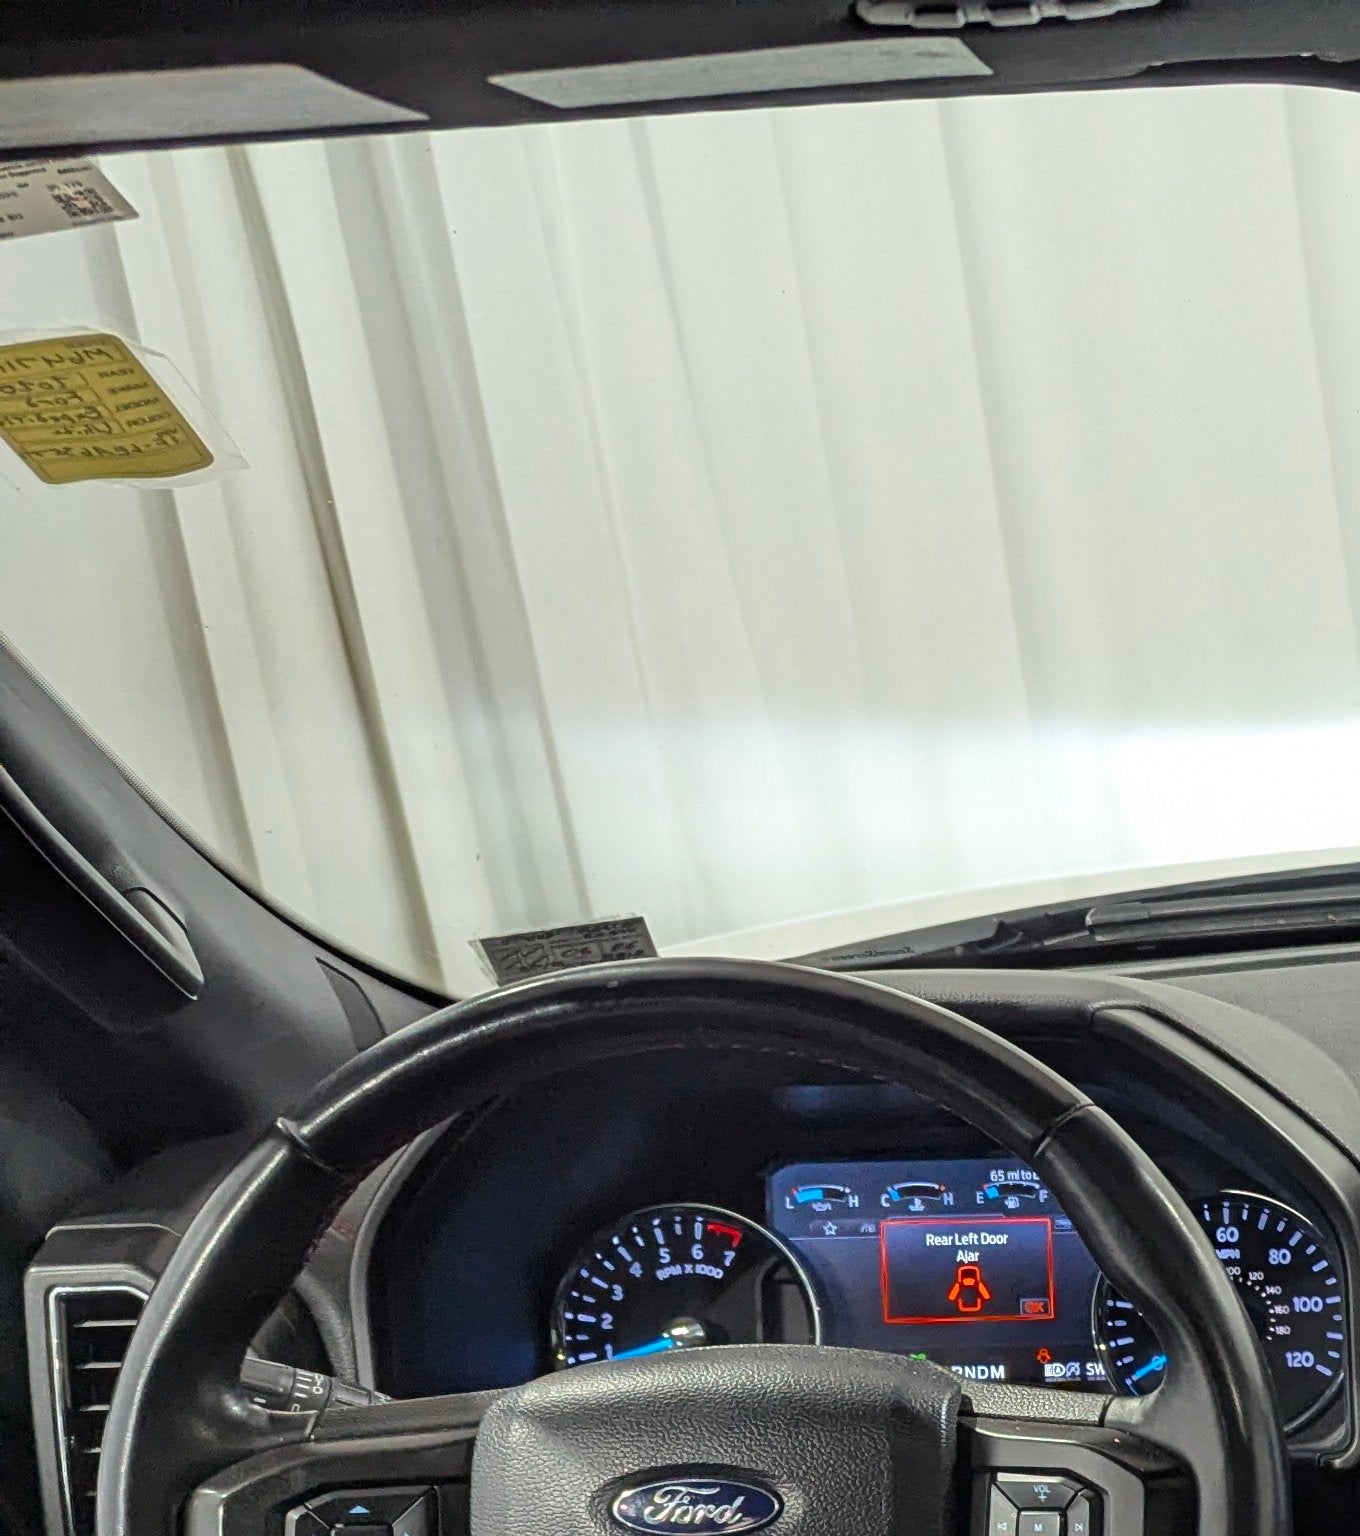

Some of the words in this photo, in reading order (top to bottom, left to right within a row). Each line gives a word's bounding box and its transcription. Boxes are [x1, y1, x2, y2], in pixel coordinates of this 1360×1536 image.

[990, 1170, 1005, 1182] 65
[785, 1197, 794, 1210] L
[848, 1195, 859, 1208] H
[880, 1194, 890, 1208] C
[943, 1193, 953, 1206] H
[976, 1191, 984, 1204] E
[926, 1233, 953, 1246] Rear
[954, 1232, 978, 1246] Left
[981, 1231, 1009, 1245] Door
[1215, 1226, 1239, 1243] 60
[658, 1247, 671, 1264] 5
[691, 1244, 704, 1260] 6
[723, 1250, 736, 1267] 7
[956, 1250, 979, 1263] Ajar
[1268, 1248, 1292, 1265] 80
[628, 1262, 643, 1278] 4
[655, 1264, 682, 1281] RPM
[695, 1264, 724, 1279] 1000
[1248, 1271, 1265, 1281] 120
[611, 1284, 624, 1301] 3
[1265, 1285, 1282, 1295] 140
[1274, 1305, 1290, 1315] 160
[1292, 1296, 1324, 1313] 100
[601, 1312, 613, 1330] 2
[1275, 1326, 1291, 1335] 180
[604, 1343, 613, 1360] 1
[1285, 1351, 1315, 1368] 120
[1032, 1484, 1051, 1494] VOL
[643, 1485, 746, 1525] Ford
[1034, 1523, 1043, 1532] M
